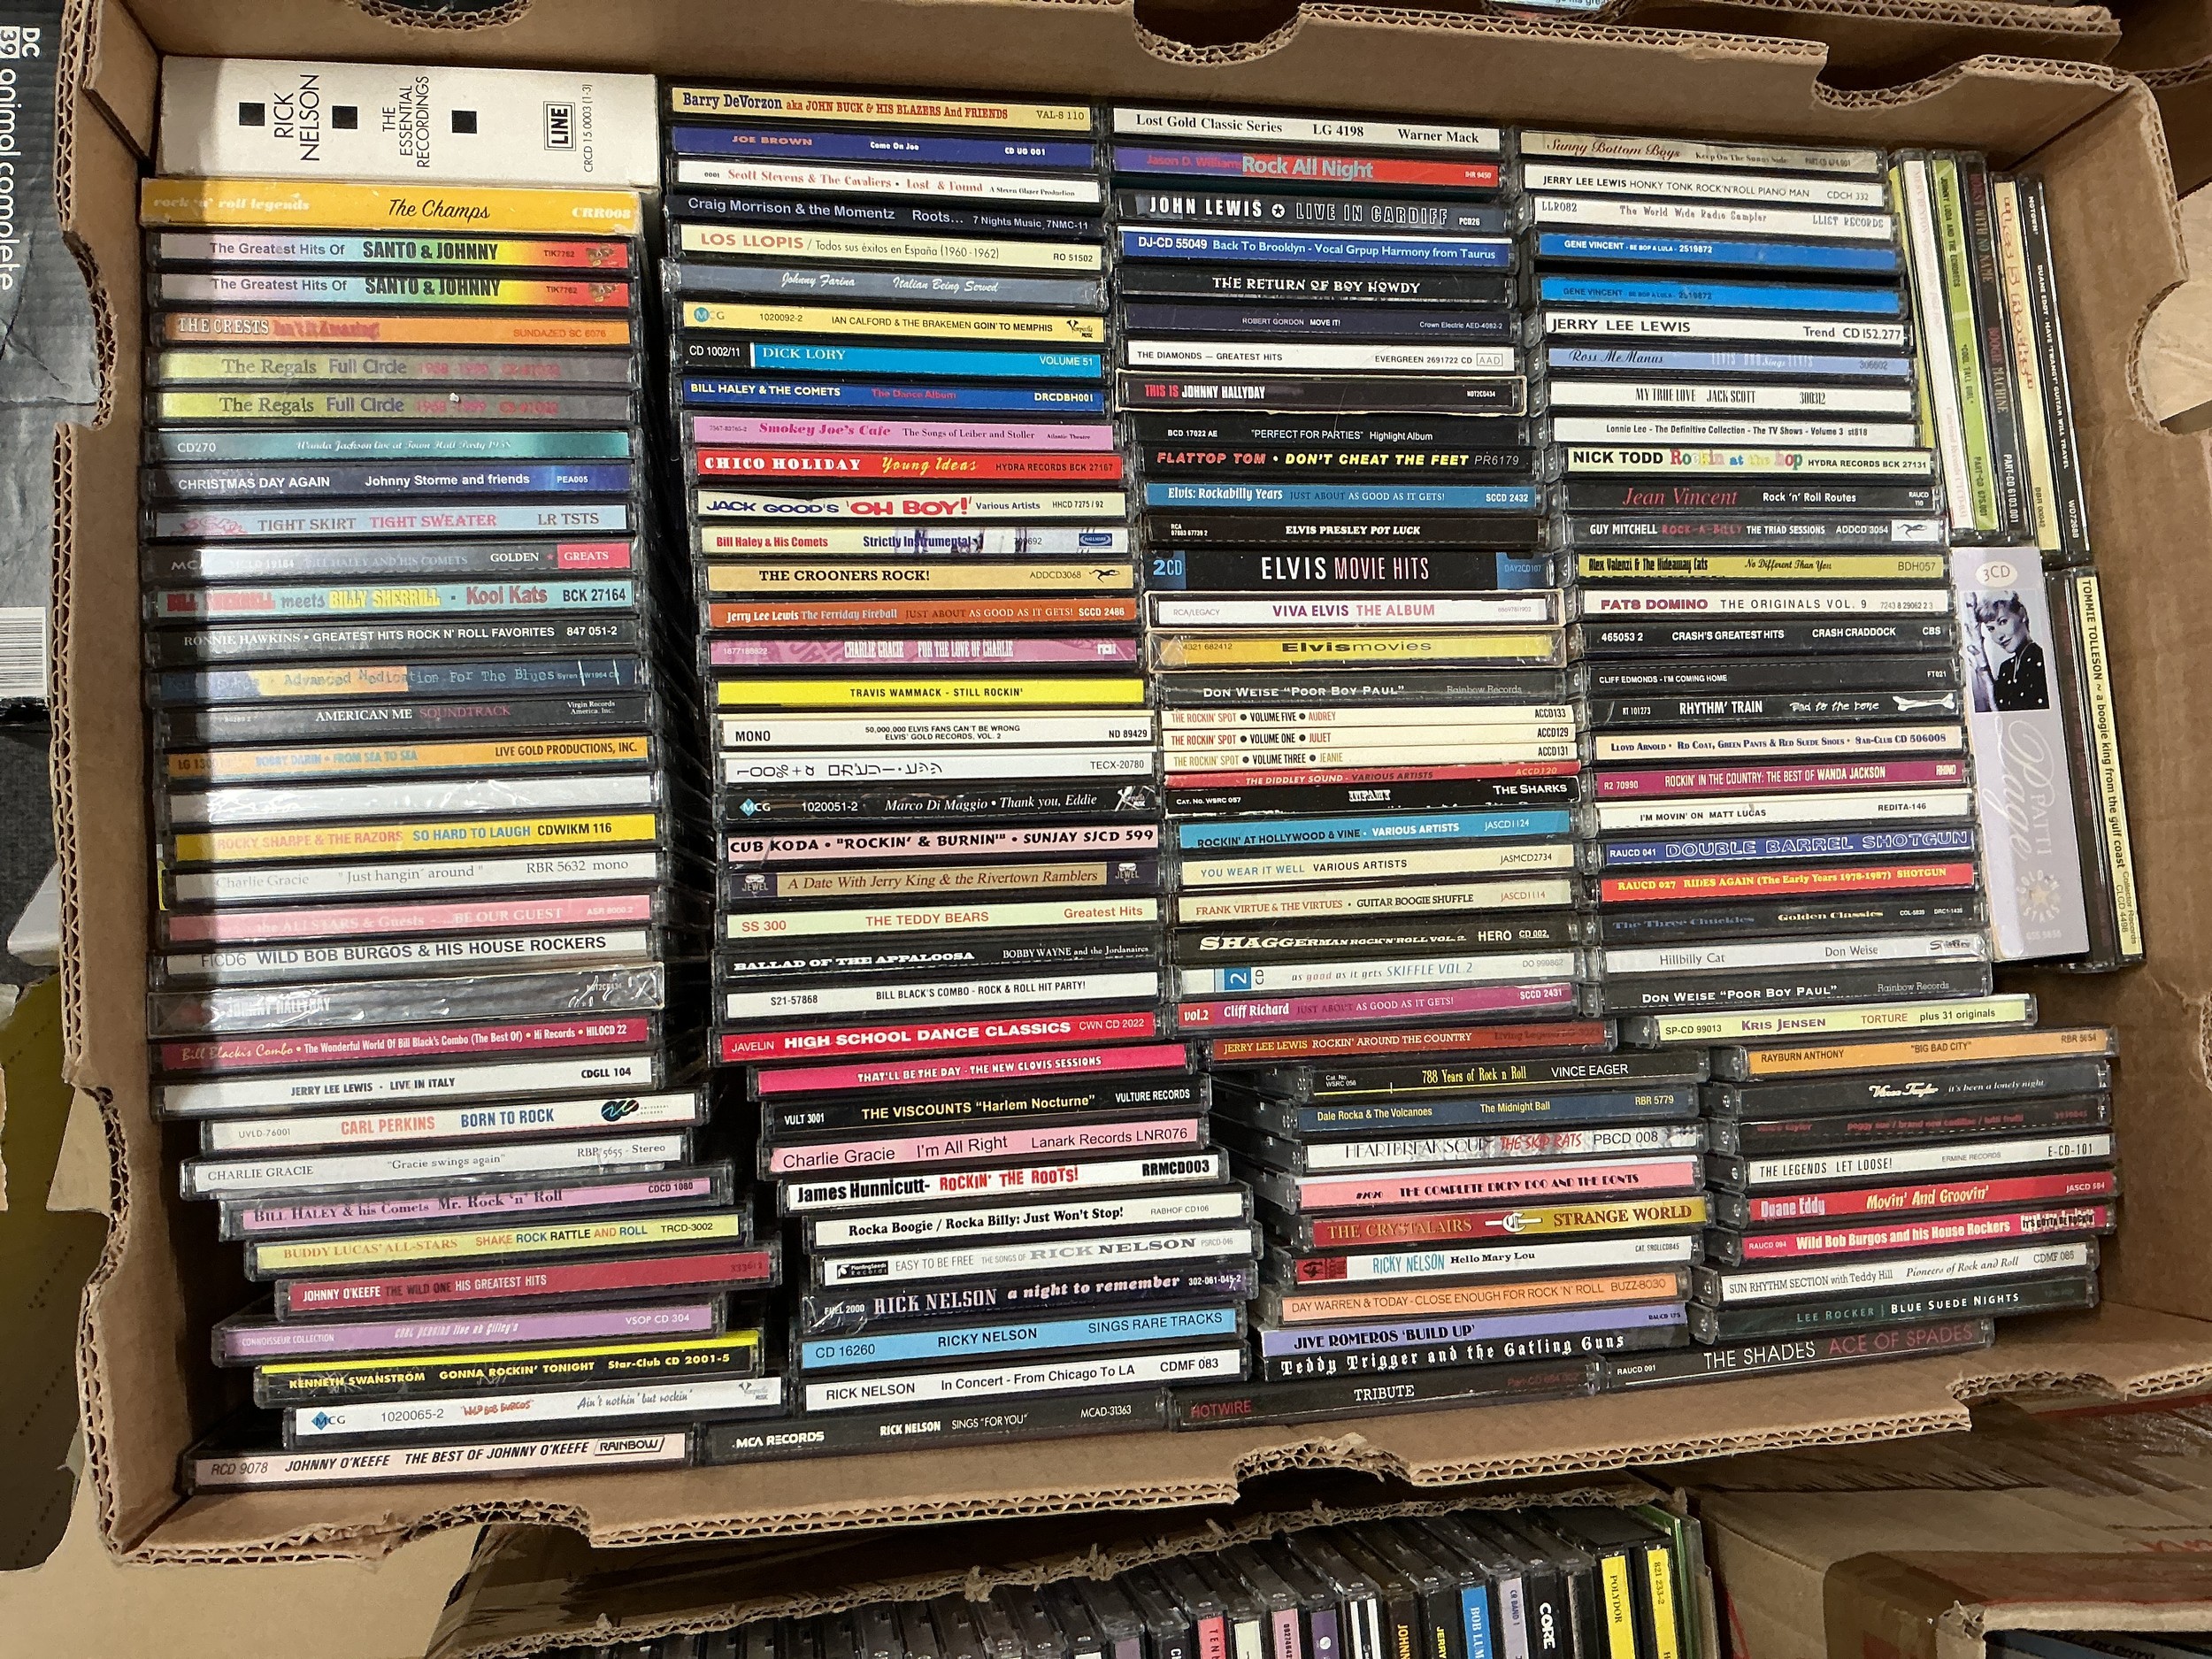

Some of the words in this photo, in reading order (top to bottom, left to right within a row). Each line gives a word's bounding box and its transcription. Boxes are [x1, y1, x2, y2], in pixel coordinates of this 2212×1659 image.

[22, 27, 41, 58] DC
[683, 92, 720, 110] Barry
[724, 94, 782, 110] DeVorzon
[274, 92, 294, 139] RICK
[300, 73, 320, 161] NELSON
[383, 106, 395, 132] THE
[400, 85, 413, 157] ESSENTIAL
[418, 76, 430, 168] RECORDINGS
[550, 108, 569, 144] LINE
[1136, 114, 1163, 127] Lost
[1167, 116, 1196, 128] Gold
[1201, 118, 1242, 131] Classic
[1247, 119, 1282, 133] Series
[1313, 124, 1332, 135] LG
[1336, 125, 1364, 137] 4198
[1397, 128, 1442, 142] Warner
[1447, 131, 1479, 143] Mack
[1826, 190, 1852, 200] CDCH
[1855, 191, 1869, 200] 332
[389, 199, 417, 218] The
[422, 199, 489, 220] Champs
[701, 233, 736, 247] LOS
[742, 235, 803, 250] LLOPIS
[1213, 240, 1239, 251] Back
[1241, 241, 1256, 252] To
[1259, 241, 1305, 255] Brooklyn
[1314, 243, 1343, 255] Vocal
[1346, 244, 1379, 257] Grpup
[1381, 245, 1430, 259] Harmony
[1432, 246, 1457, 257] from
[1460, 248, 1495, 259] Taurus
[210, 243, 234, 254] The
[238, 242, 297, 255] Greatest
[301, 244, 324, 255] Hits
[328, 244, 344, 255] Of
[364, 242, 417, 259] SANTO
[421, 244, 433, 260] &
[437, 242, 497, 261] JOHNNY
[759, 313, 803, 322] 1020092-2
[1552, 318, 1598, 333] JERRY
[1606, 319, 1634, 332] LEE
[1641, 320, 1691, 333] LEWIS
[1803, 326, 1835, 337] Trend
[689, 346, 703, 357] CD
[707, 346, 740, 358] 1002/11
[764, 348, 800, 358] DICK
[805, 348, 845, 361] LORY
[1040, 356, 1080, 365] VOLUME
[1083, 357, 1093, 365] 51
[178, 442, 216, 453] CD270
[704, 457, 766, 470] CHICO
[772, 457, 861, 472] HOLIDAY
[1573, 450, 1614, 465] NICK
[1619, 450, 1663, 464] TODD
[179, 478, 255, 489] CHRISTMAS
[258, 477, 285, 488] DAY
[288, 477, 330, 488] AGAIN
[365, 475, 410, 488] Johnny
[414, 474, 457, 486] Storme
[461, 473, 483, 485] and
[487, 472, 529, 485] friends
[557, 475, 588, 484] PEA005
[976, 501, 1009, 510] Various
[1623, 488, 1664, 505] Jean
[1673, 488, 1737, 504] Vincent
[1763, 492, 1786, 502] Rock
[1804, 493, 1822, 502] Roll
[1824, 493, 1856, 502] Routes
[759, 571, 790, 580] THE
[795, 570, 878, 580] CROONERS
[881, 570, 930, 580] ROCK!
[1262, 557, 1326, 580] ELVIS
[1335, 557, 1386, 580] MOVIE
[1393, 557, 1429, 580] HITS
[1721, 600, 1746, 609] THE
[1751, 599, 1822, 609] ORIGINALS
[1826, 599, 1855, 609] VOL.
[1861, 599, 1867, 608] 9
[2082, 580, 2094, 623] TOMMIE
[1923, 626, 1941, 635] CBS
[2086, 626, 2103, 680] TOLLESON
[1535, 708, 1566, 718] ACCD133
[2097, 703, 2109, 741] boogie
[735, 731, 771, 741] MONO
[2102, 743, 2114, 764] king
[2106, 769, 2115, 794] from
[801, 801, 857, 812] 1020051-2
[1878, 803, 1926, 811] REDITA-146
[2108, 797, 2116, 814] the
[2109, 818, 2119, 837] gulf
[2114, 840, 2124, 869] coast
[865, 915, 893, 926] THE
[897, 913, 941, 926] TEDDY
[945, 910, 989, 923] BEARS
[1479, 930, 1512, 942] HERO
[257, 950, 298, 964] WILD
[304, 949, 338, 963] BOB
[344, 945, 411, 961] BURGOS
[419, 945, 429, 956] &
[435, 943, 463, 956] HIS
[469, 940, 525, 955] HOUSE
[530, 937, 605, 951] ROCKERS
[1660, 953, 1701, 967] Hillbilly
[1707, 953, 1724, 964] Cat
[1824, 946, 1845, 957] Don
[1848, 944, 1878, 956] Weise
[732, 1041, 773, 1053] JAVELIN
[785, 1034, 830, 1048] HIGH
[835, 1028, 911, 1047] SCHOOL
[917, 1025, 979, 1042] DANCE
[984, 1021, 1071, 1039] CLASSICS
[1551, 1065, 1586, 1077] VINCE
[1589, 1063, 1628, 1076] EAGER
[342, 1119, 375, 1135] CARL
[379, 1116, 435, 1133] PERKINS
[461, 1111, 497, 1127] BORN
[502, 1110, 516, 1125] TO
[519, 1109, 554, 1124] ROCK
[783, 1149, 840, 1168] Charlie
[844, 1146, 895, 1164] Gracie
[944, 1138, 964, 1156] All
[968, 1136, 1007, 1155] Right
[1031, 1133, 1075, 1149] Lanark
[1079, 1130, 1133, 1146] Records
[1136, 1126, 1187, 1142] LNR076
[1554, 1210, 1627, 1227] STRANGE
[1632, 1204, 1692, 1222] WORLD
[516, 1231, 547, 1244] ROCK
[550, 1228, 590, 1242] RATTLE
[594, 1226, 616, 1238] AND
[619, 1225, 647, 1237] ROLL
[661, 1221, 712, 1233] TRCD-3002
[1704, 1352, 1740, 1370] THE
[1743, 1343, 1816, 1365] SHADES
[826, 1387, 858, 1401] RICK
[862, 1383, 915, 1399] NELSON
[941, 1379, 953, 1391] In
[956, 1375, 1002, 1390] Concert
[1015, 1371, 1045, 1386] From
[1048, 1367, 1097, 1386] Chicago
[1102, 1366, 1116, 1379] To
[1119, 1364, 1135, 1376] LA
[1161, 1359, 1194, 1373] CDMF
[1199, 1357, 1218, 1371] 083
[1355, 1385, 1415, 1402] TRIBUTE
[600, 1439, 659, 1452] RAINBOW
[285, 1456, 336, 1472] JOHNNY
[405, 1450, 431, 1465] THE
[435, 1448, 465, 1463] BEST
[469, 1447, 484, 1461] OF
[488, 1444, 536, 1461] JOHNNY
[1609, 1575, 1623, 1624] POLYDOR
